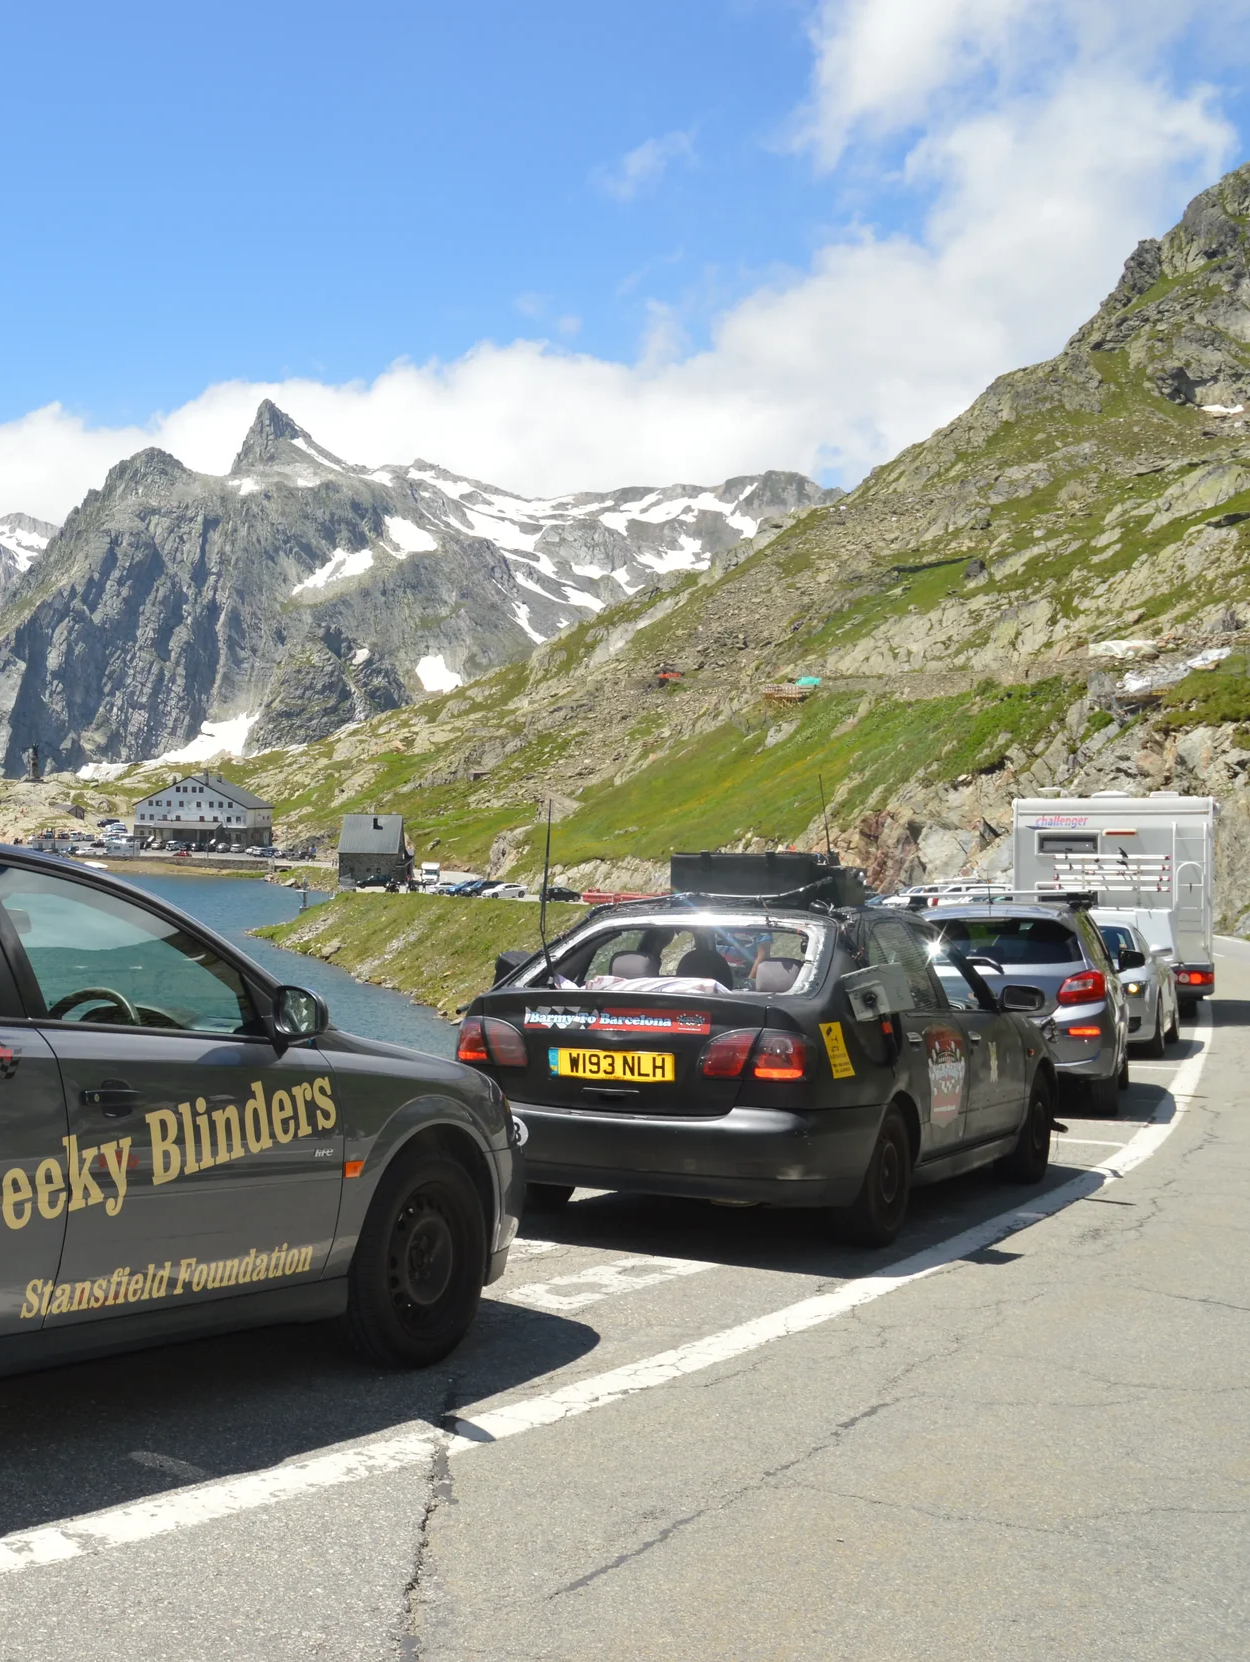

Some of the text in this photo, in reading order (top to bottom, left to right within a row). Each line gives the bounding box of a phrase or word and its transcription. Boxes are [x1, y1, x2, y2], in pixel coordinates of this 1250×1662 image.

[1035, 813, 1089, 829] challenger
[529, 1011, 574, 1026] Barmy
[578, 1013, 597, 1024] To
[599, 1012, 672, 1027] Barcelona
[569, 1052, 666, 1078] W193 NLH
[145, 1076, 337, 1186] Blinders
[314, 1148, 334, 1158] life
[20, 1261, 172, 1319] Stansfield
[173, 1242, 313, 1293] Foundation
